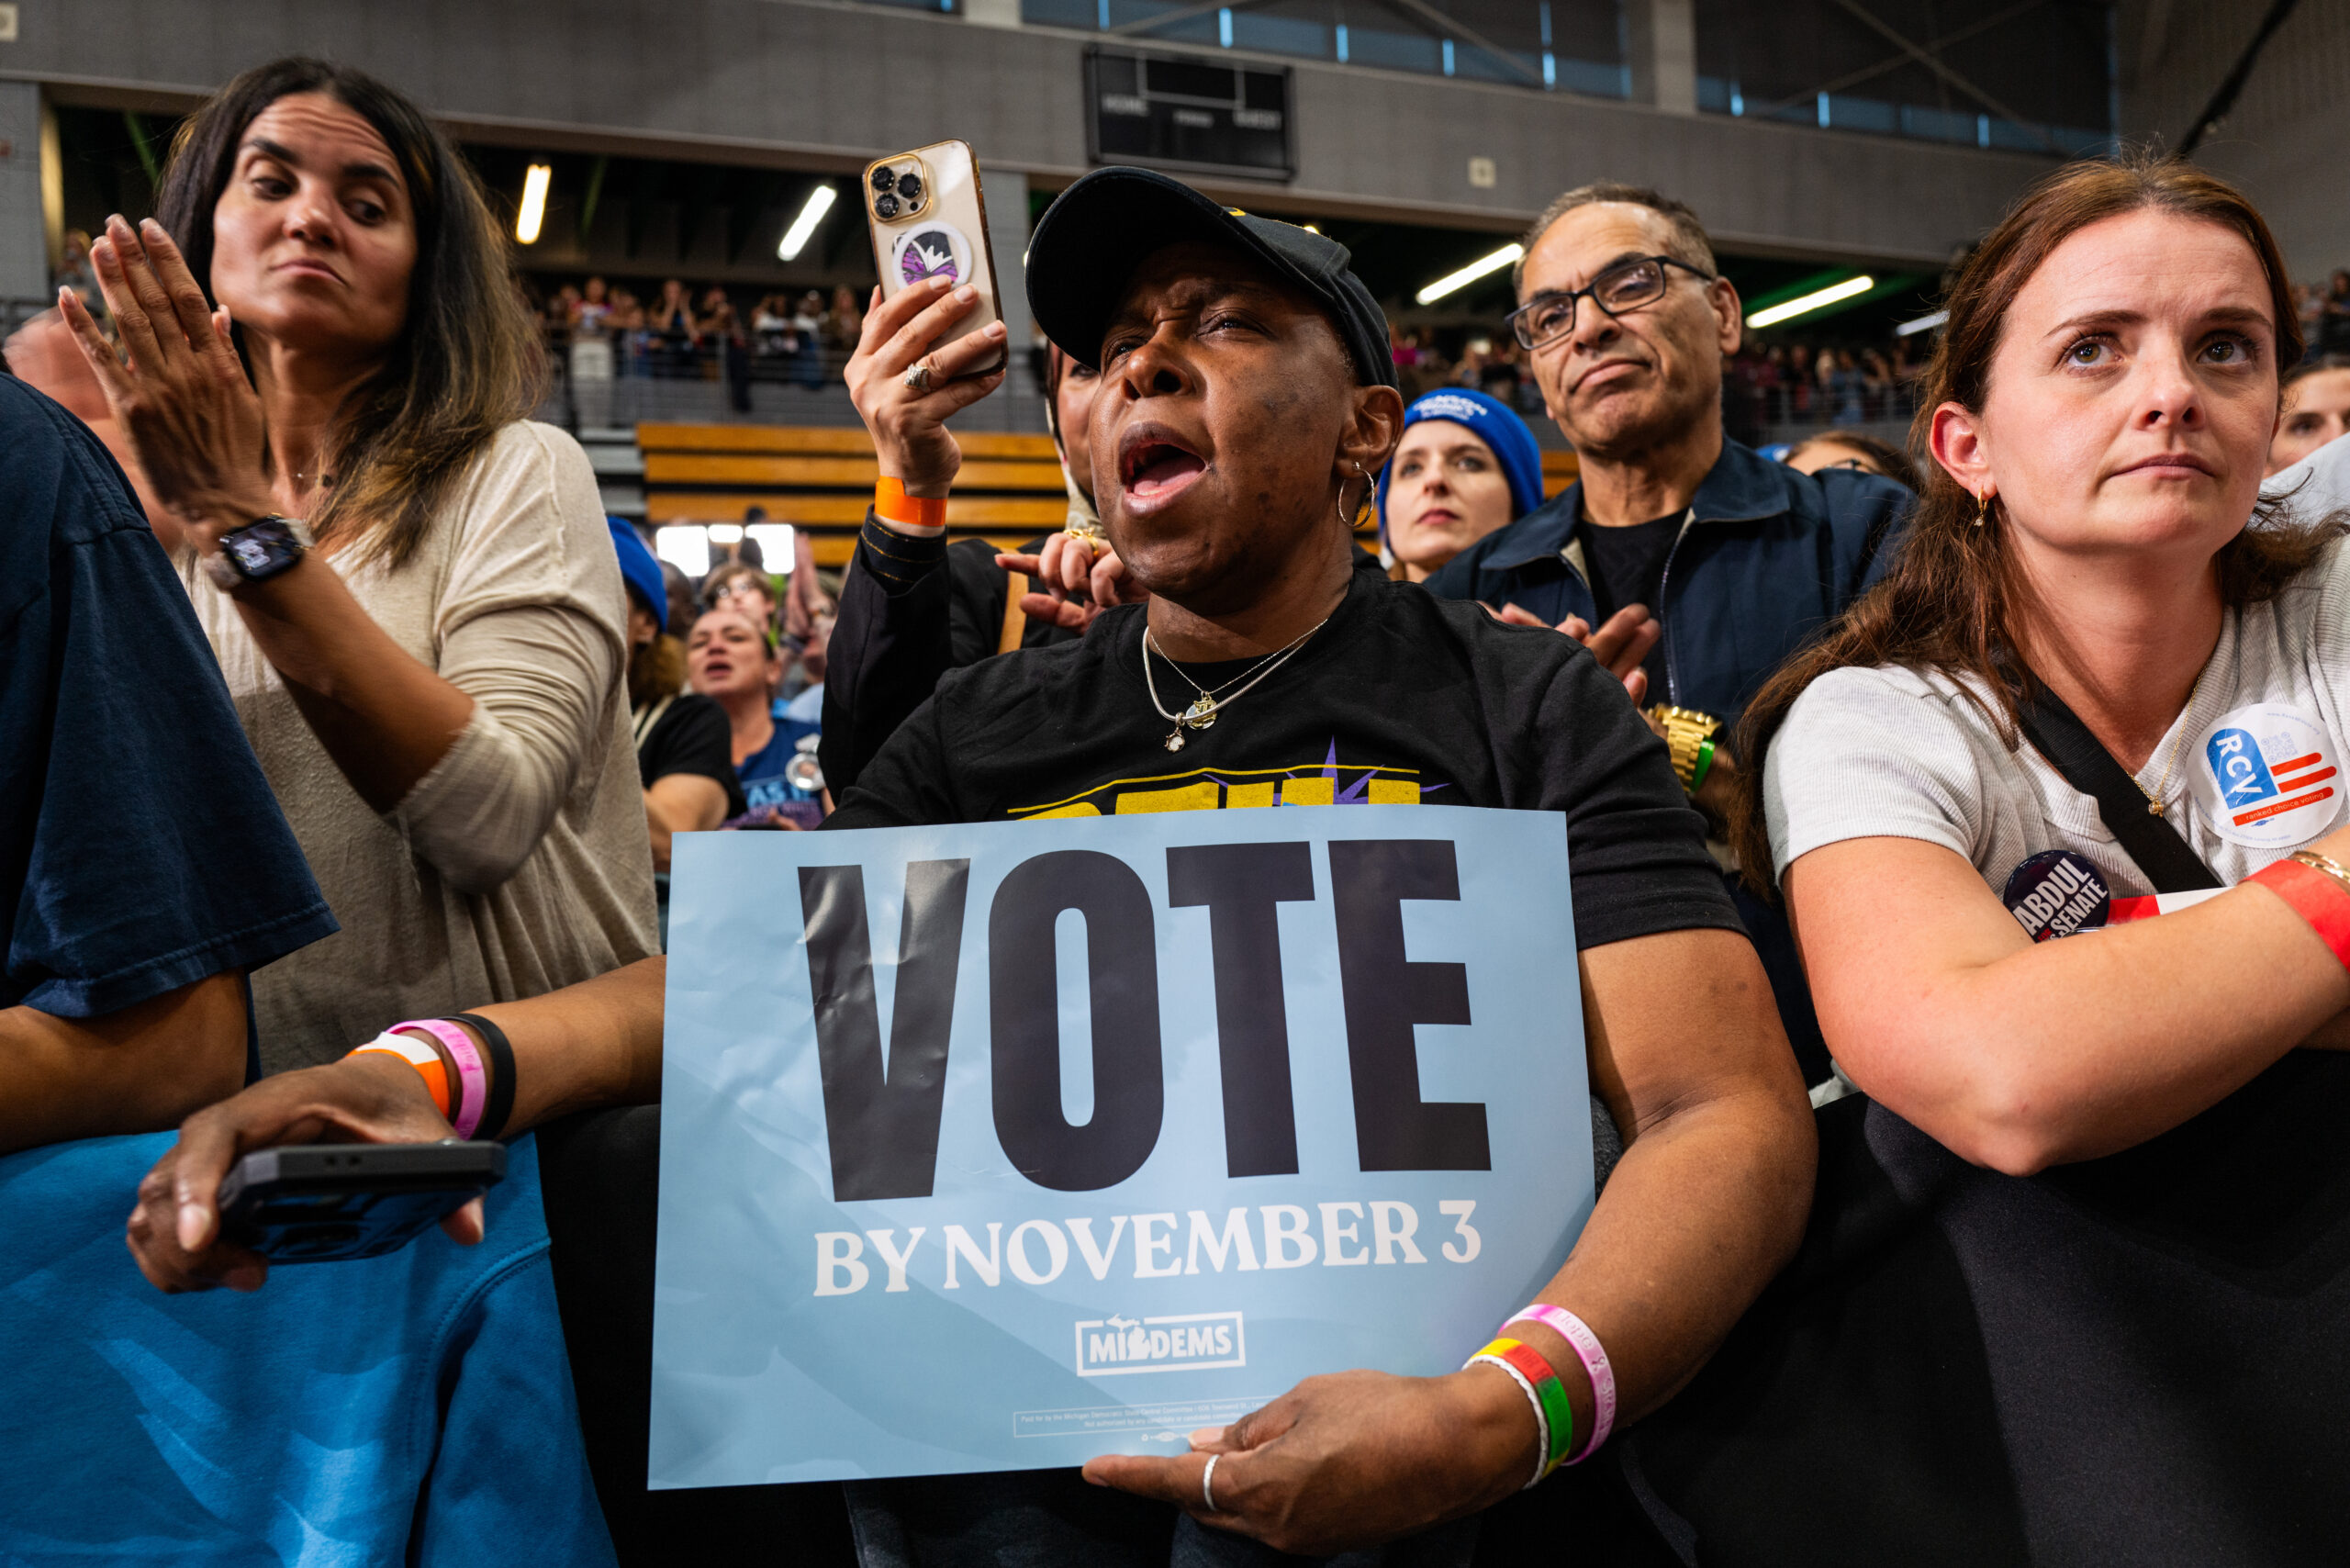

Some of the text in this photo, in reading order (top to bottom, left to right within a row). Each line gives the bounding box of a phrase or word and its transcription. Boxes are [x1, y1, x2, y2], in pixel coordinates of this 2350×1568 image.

[2216, 734, 2264, 794] RCV
[2245, 791, 2325, 822] ranked choice voting
[2012, 857, 2091, 936] ABDUL
[2049, 877, 2109, 935] SENATE
[2037, 927, 2052, 942] FOR
[797, 839, 1492, 1202] VOTE
[813, 1199, 1483, 1297] BY NOVEMBER 3
